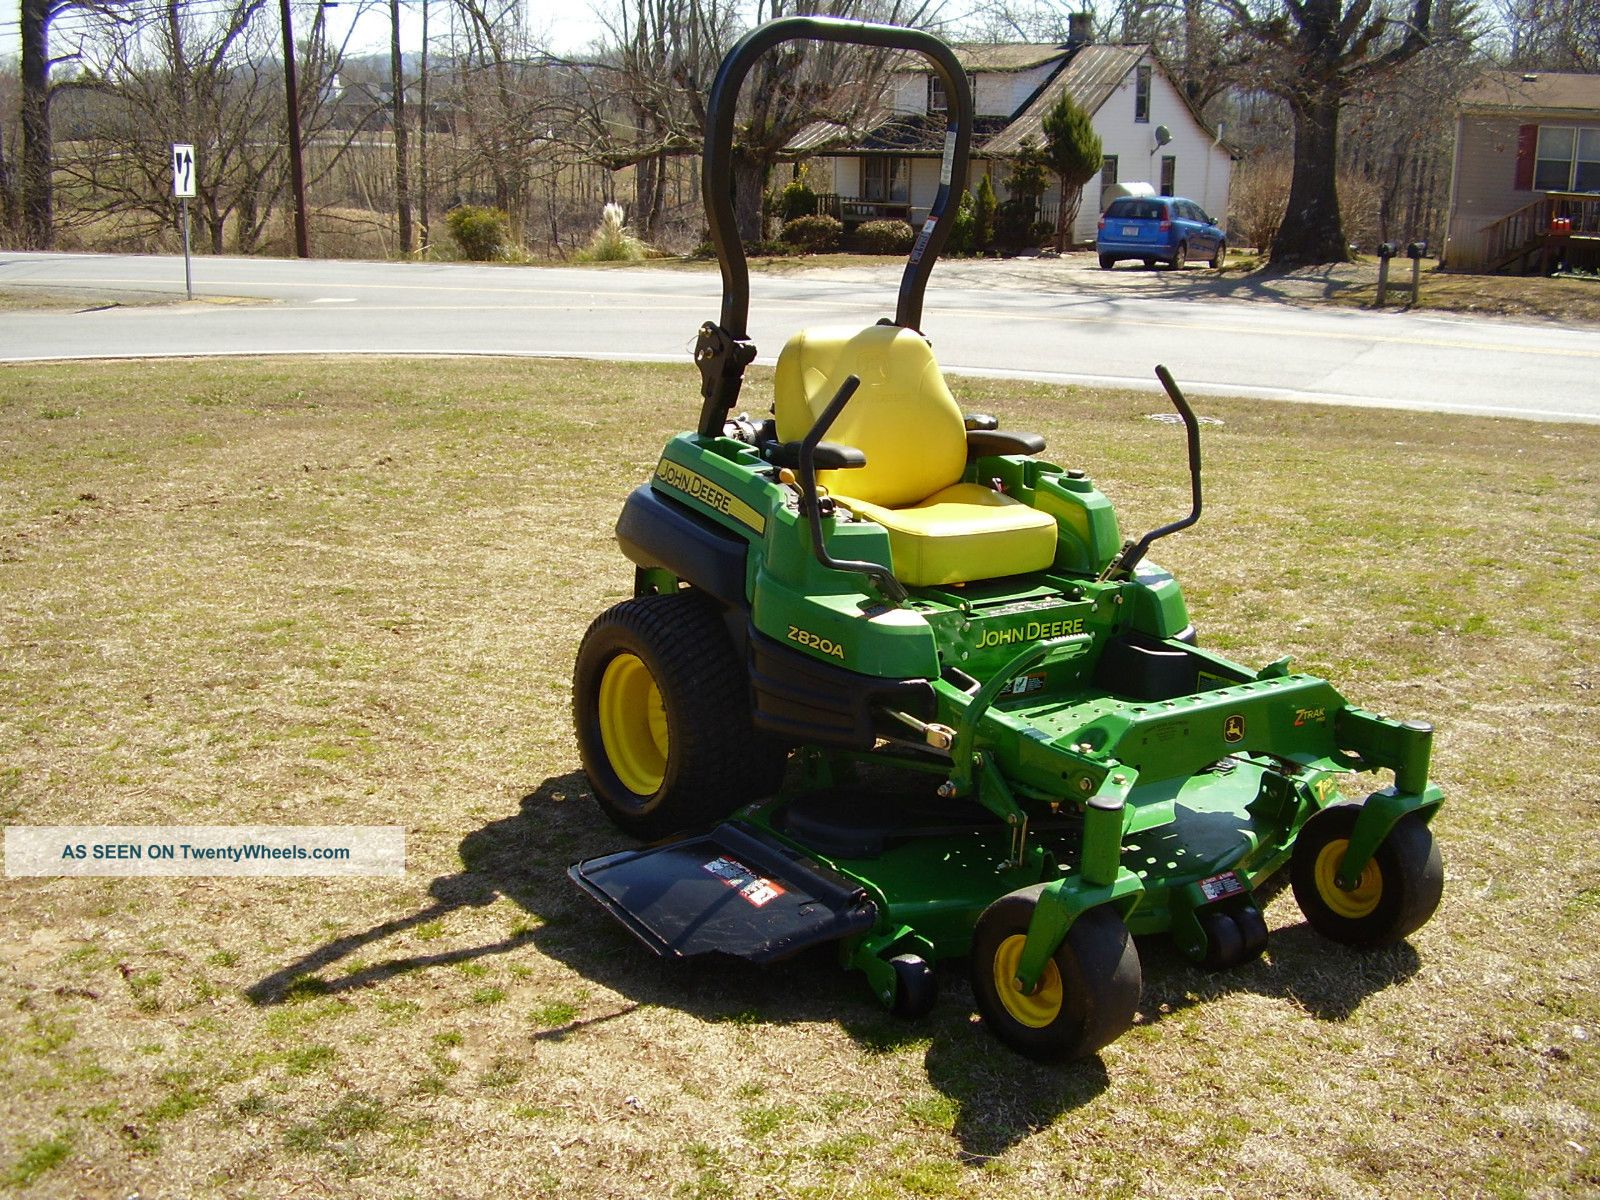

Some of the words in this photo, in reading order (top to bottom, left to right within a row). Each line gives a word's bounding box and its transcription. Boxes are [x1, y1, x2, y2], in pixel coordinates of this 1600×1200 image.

[660, 463, 691, 491] JOHN
[690, 477, 731, 512] DEERE
[787, 625, 845, 660] Z820A
[976, 627, 1024, 648] JOHN
[1027, 618, 1084, 640] DEERE
